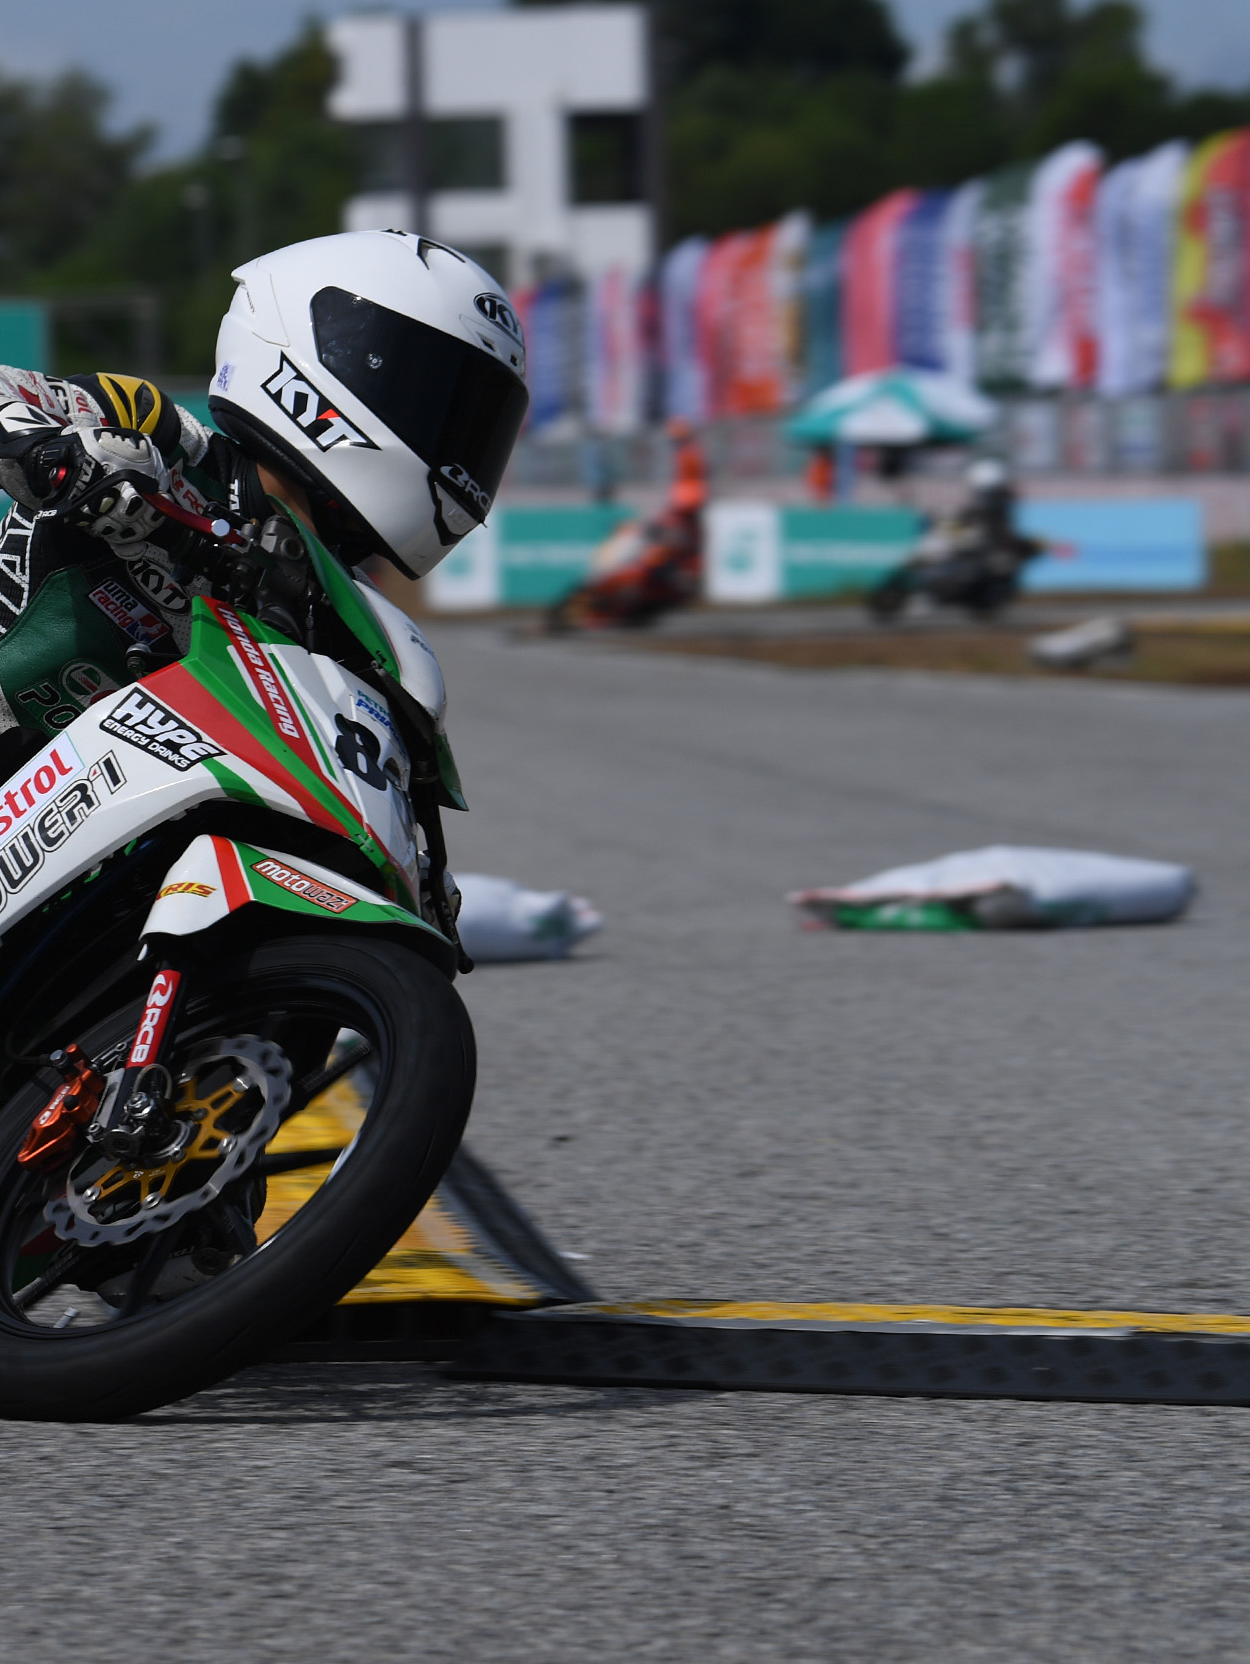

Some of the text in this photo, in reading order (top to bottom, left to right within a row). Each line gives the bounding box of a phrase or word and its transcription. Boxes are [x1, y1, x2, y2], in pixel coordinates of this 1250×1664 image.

[265, 359, 368, 447] KYT
[103, 581, 139, 612] uma
[130, 559, 190, 606] KYT
[93, 590, 136, 628] racing
[217, 607, 300, 738] Honda Racing
[17, 681, 83, 730] PO
[111, 693, 220, 761] HYPE
[103, 718, 192, 768] ENERGY DRINKS
[335, 713, 398, 791] 8
[255, 860, 350, 911] motowazi
[131, 1008, 162, 1063] RCB
